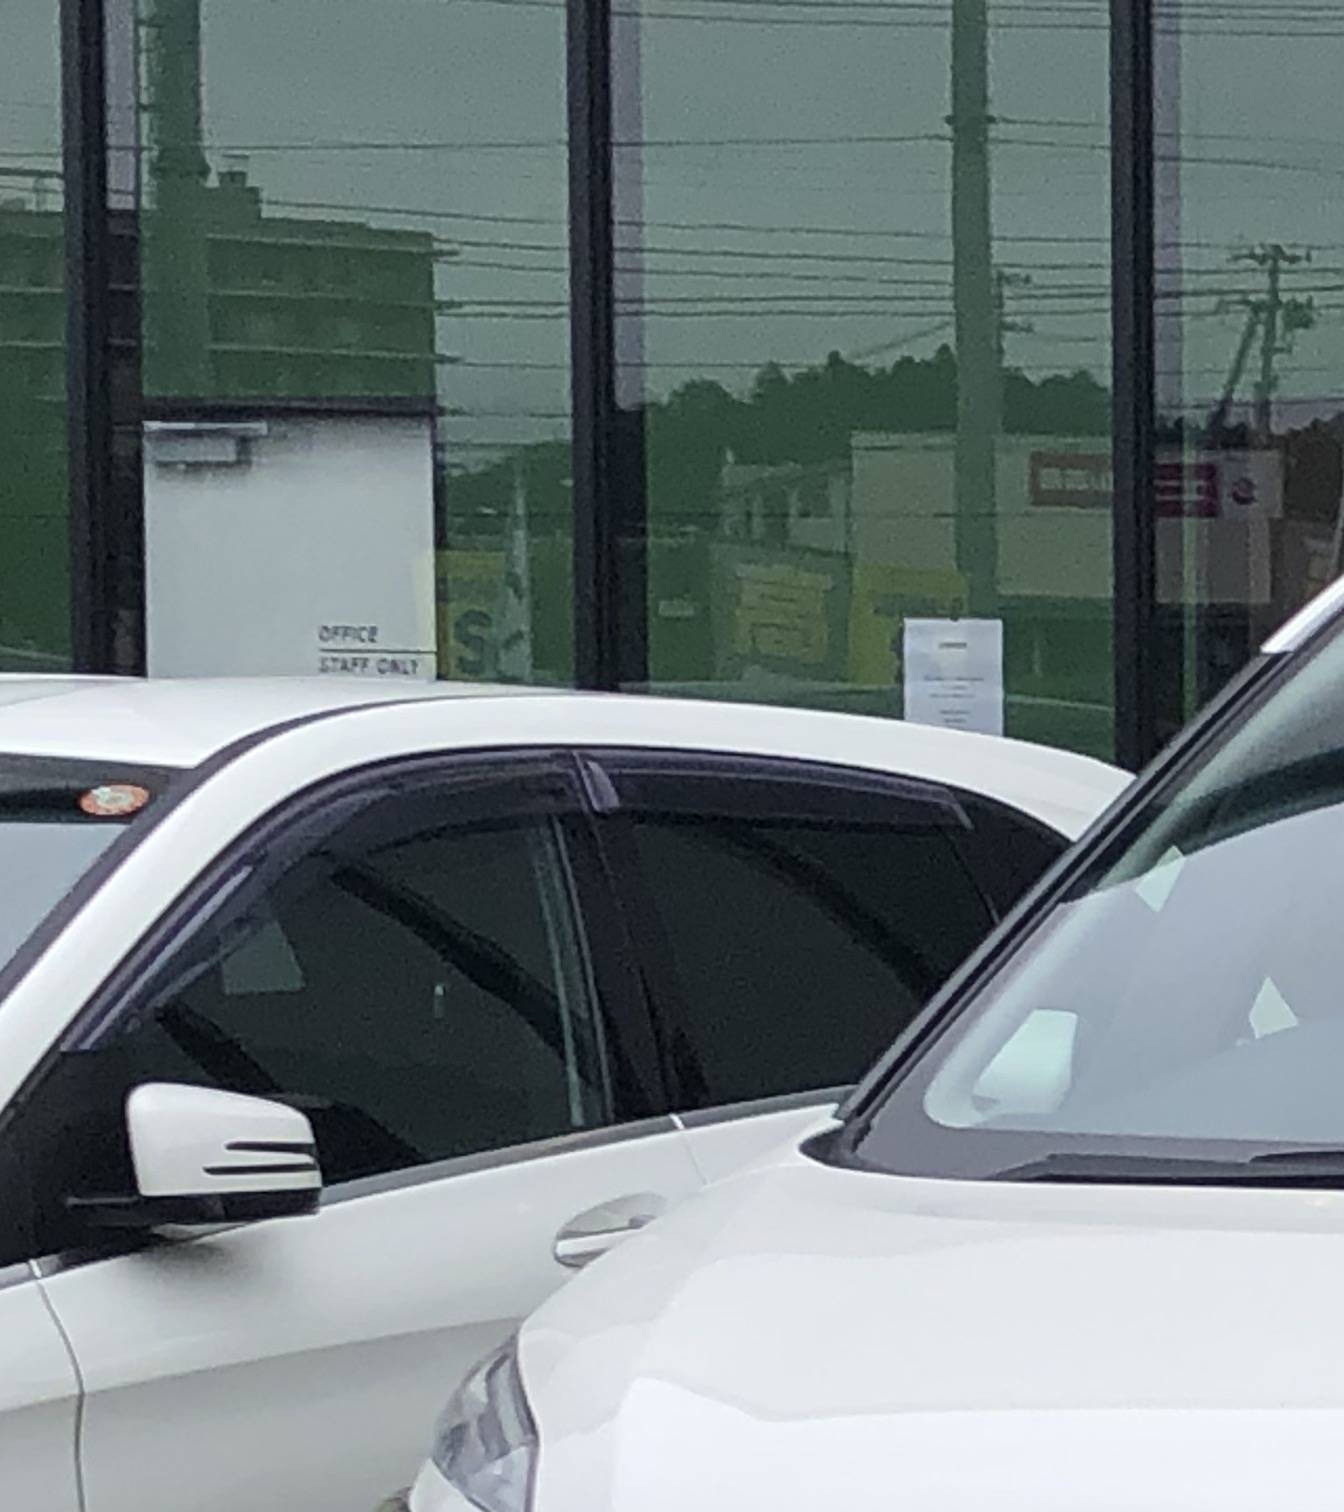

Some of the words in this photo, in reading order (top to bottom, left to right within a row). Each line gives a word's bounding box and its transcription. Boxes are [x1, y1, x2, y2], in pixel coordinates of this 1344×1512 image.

[318, 625, 379, 643] OFFICE
[319, 656, 370, 674] STAFF
[376, 658, 420, 675] ONLY
